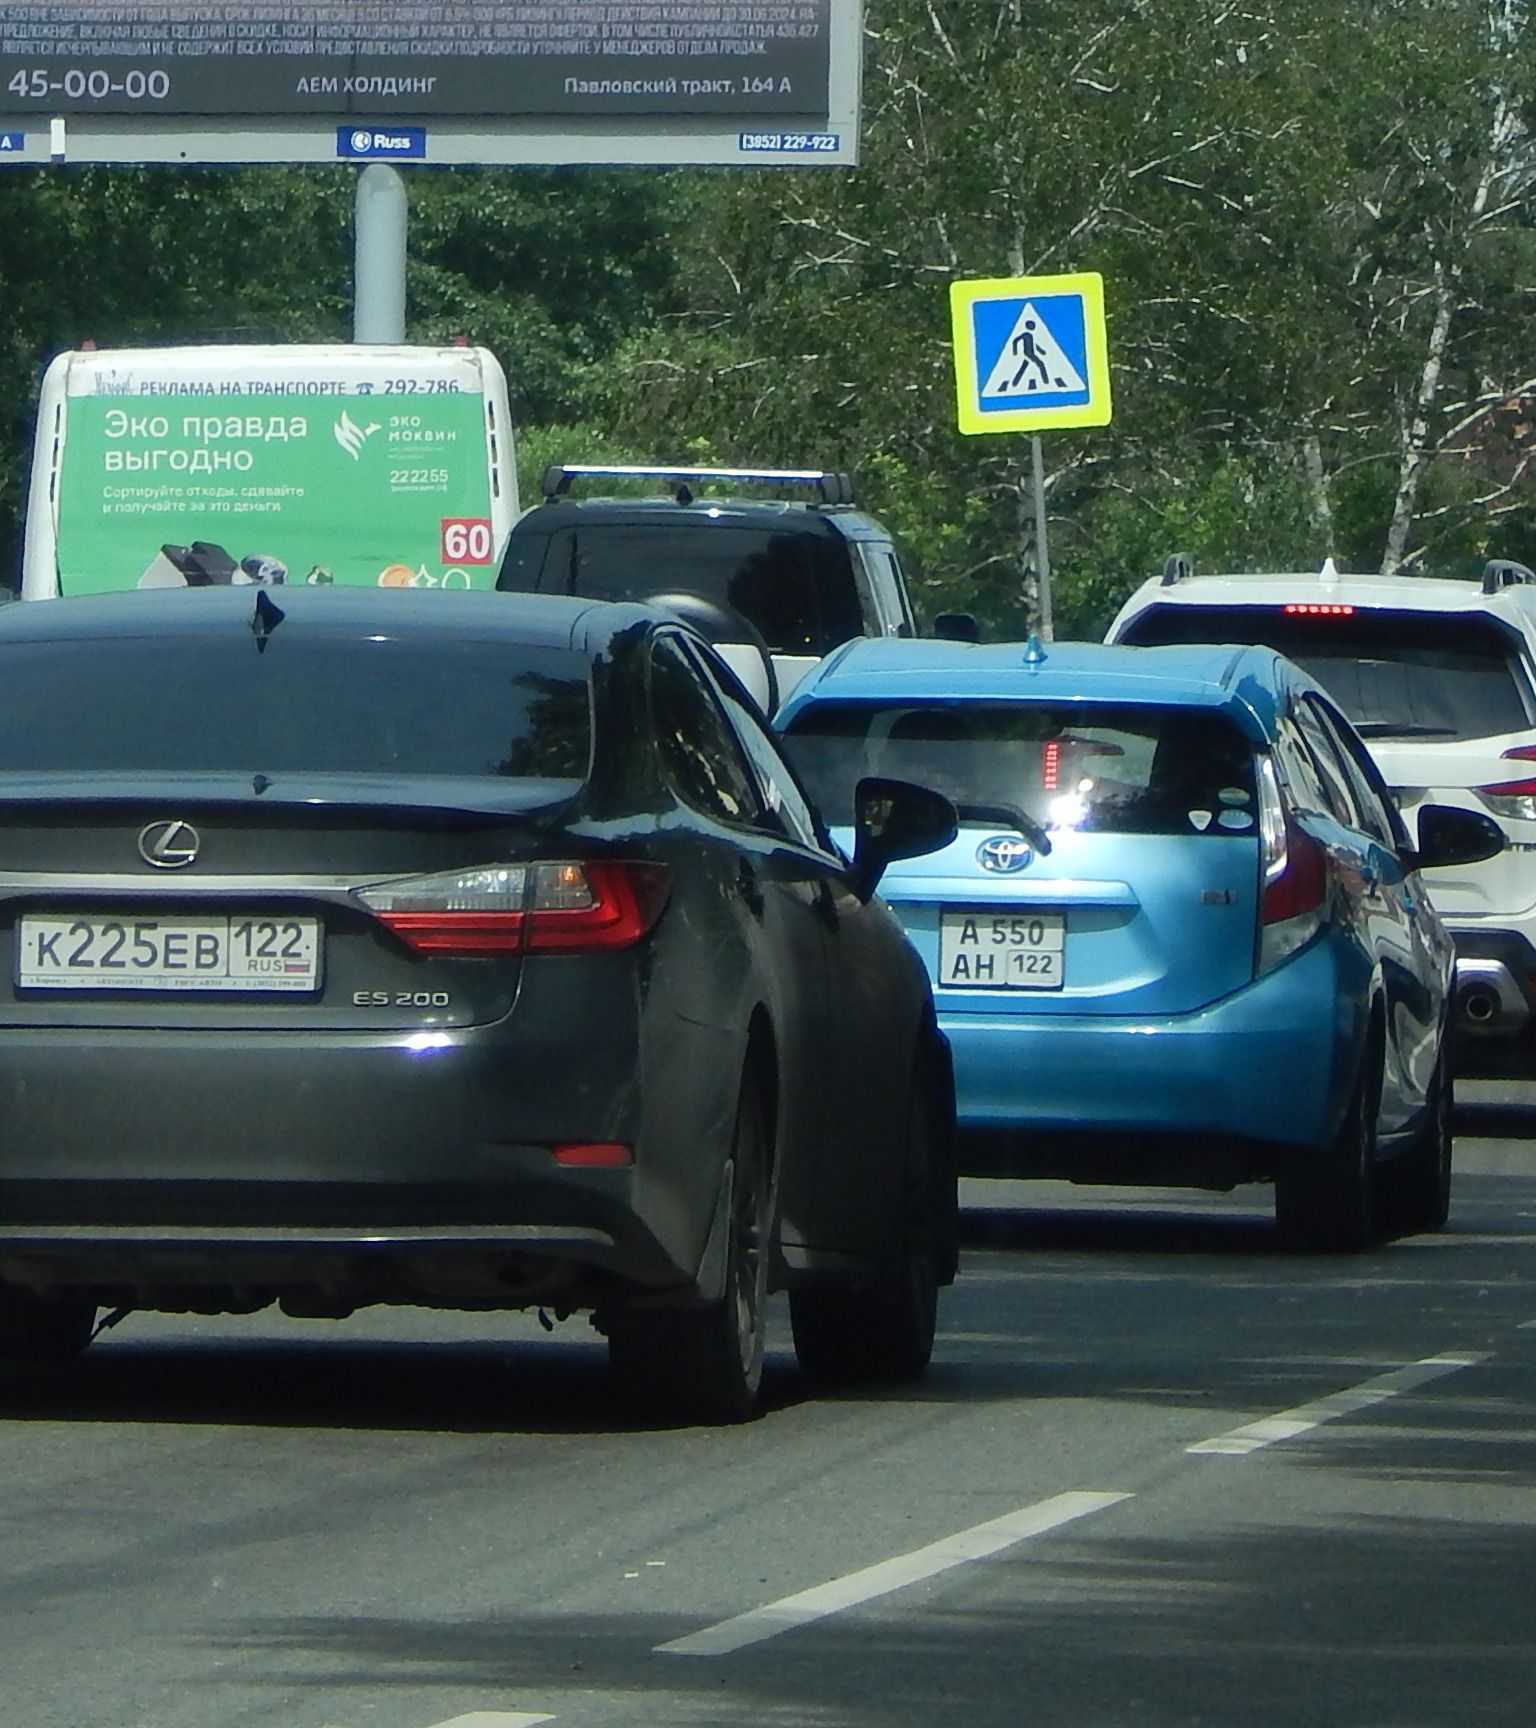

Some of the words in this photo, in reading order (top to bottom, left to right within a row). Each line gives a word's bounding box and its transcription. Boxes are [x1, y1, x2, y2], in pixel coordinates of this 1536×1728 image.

[9, 70, 169, 98] 45-00-00
[297, 76, 339, 94] АЕМ
[343, 76, 436, 97] ХОЛДИНГ
[564, 76, 675, 95] Павловский
[681, 80, 734, 97] тракт,
[741, 77, 774, 93] 164
[779, 77, 792, 93] А
[374, 134, 411, 150] Russ
[742, 134, 781, 149] (3852)
[783, 135, 836, 150] 229-922
[140, 381, 215, 396] РЕКЛАМА
[220, 381, 242, 395] НА
[246, 380, 345, 395] ТРАНСПОРТЕ
[384, 379, 459, 394] 292-786
[104, 409, 169, 439] Эко
[183, 414, 308, 443] правда
[389, 415, 421, 427] ЭКО
[104, 450, 253, 474] выгодно
[103, 485, 183, 500] Сортируйте
[241, 485, 305, 498] сдавайте
[115, 500, 186, 514] получайте
[191, 502, 206, 511] за
[445, 524, 490, 559] 60
[959, 920, 979, 945] А
[991, 919, 1044, 945] 550
[37, 921, 220, 969] К225ЕВ
[233, 922, 303, 958] 122
[247, 959, 282, 972] RUS
[951, 953, 995, 979] АН
[1013, 954, 1053, 974] 122
[352, 991, 389, 1006] ES
[395, 991, 449, 1006] 200
